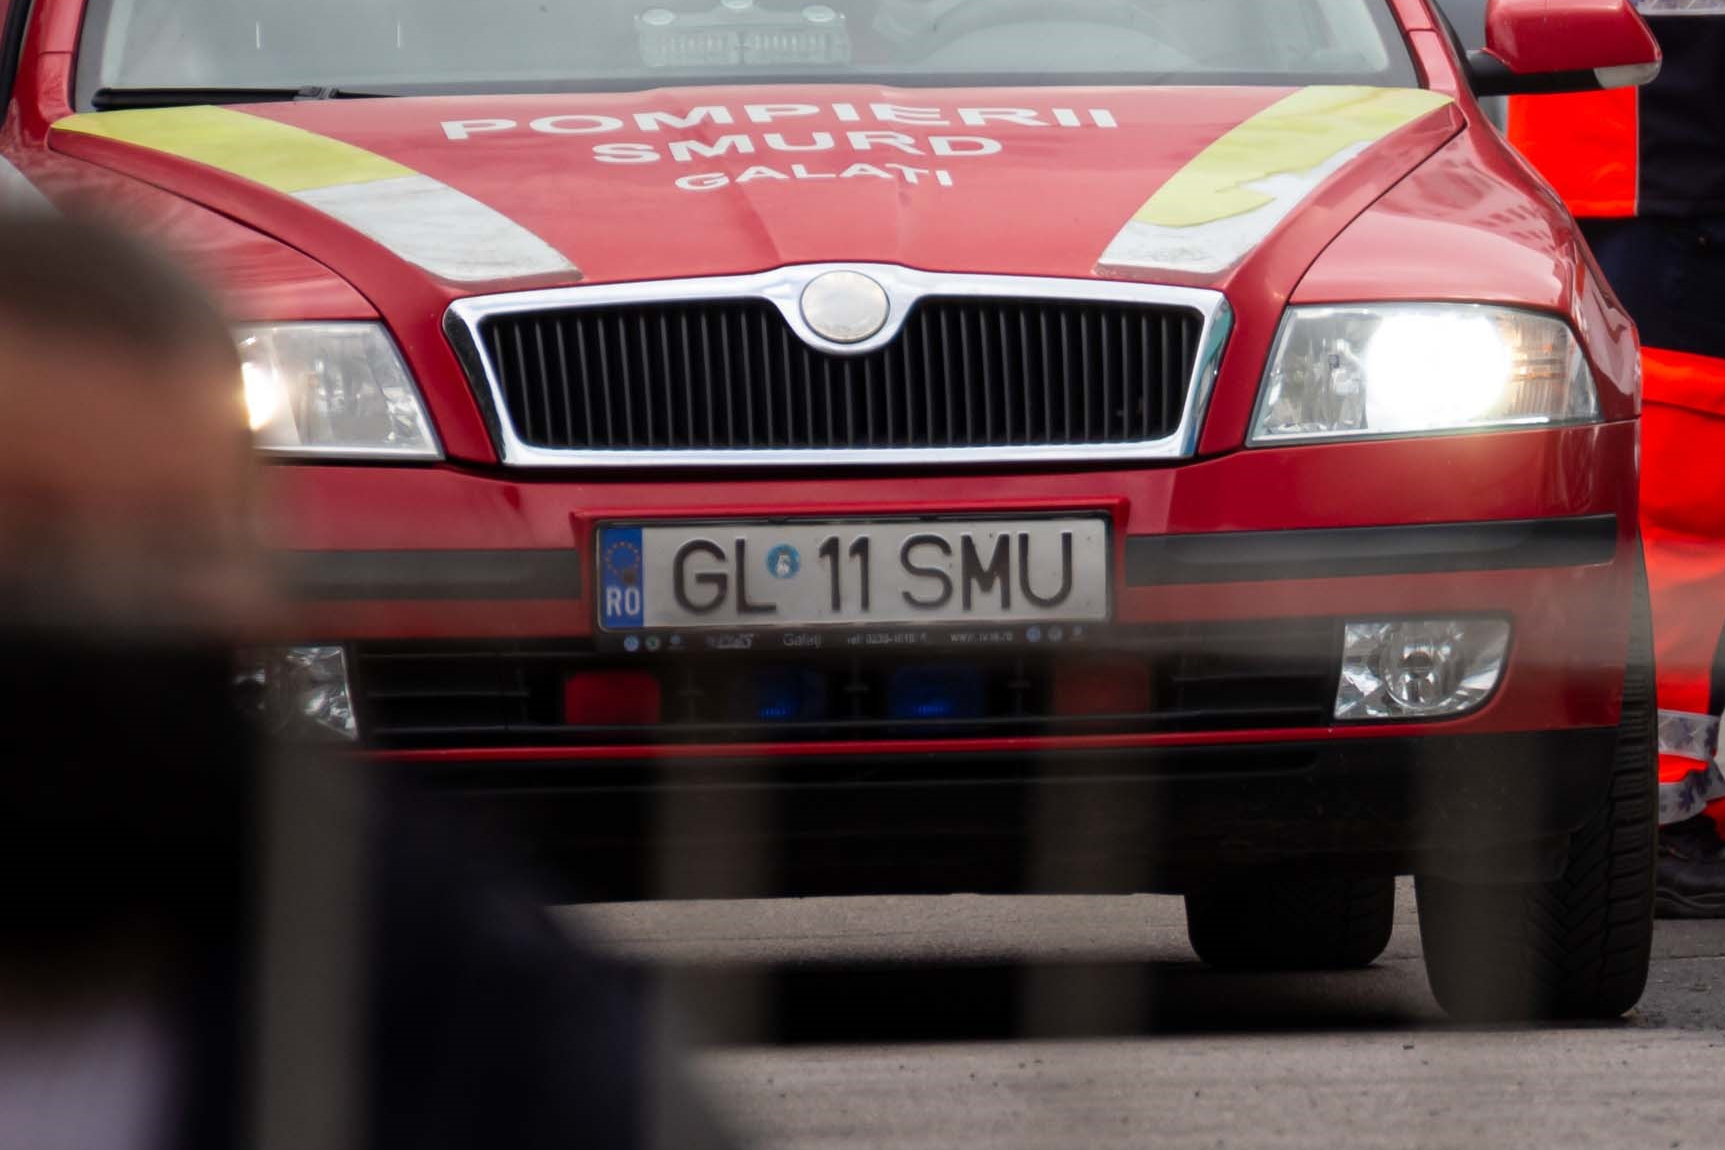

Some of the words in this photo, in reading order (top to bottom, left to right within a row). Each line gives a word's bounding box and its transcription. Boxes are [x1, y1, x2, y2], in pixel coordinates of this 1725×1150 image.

[440, 103, 1118, 140] POMPIERII
[592, 131, 1002, 164] SMURD
[674, 163, 953, 190] GALATI
[673, 538, 777, 614] GL
[818, 535, 871, 613] 11
[901, 532, 1073, 612] SMU
[606, 585, 641, 617] RO
